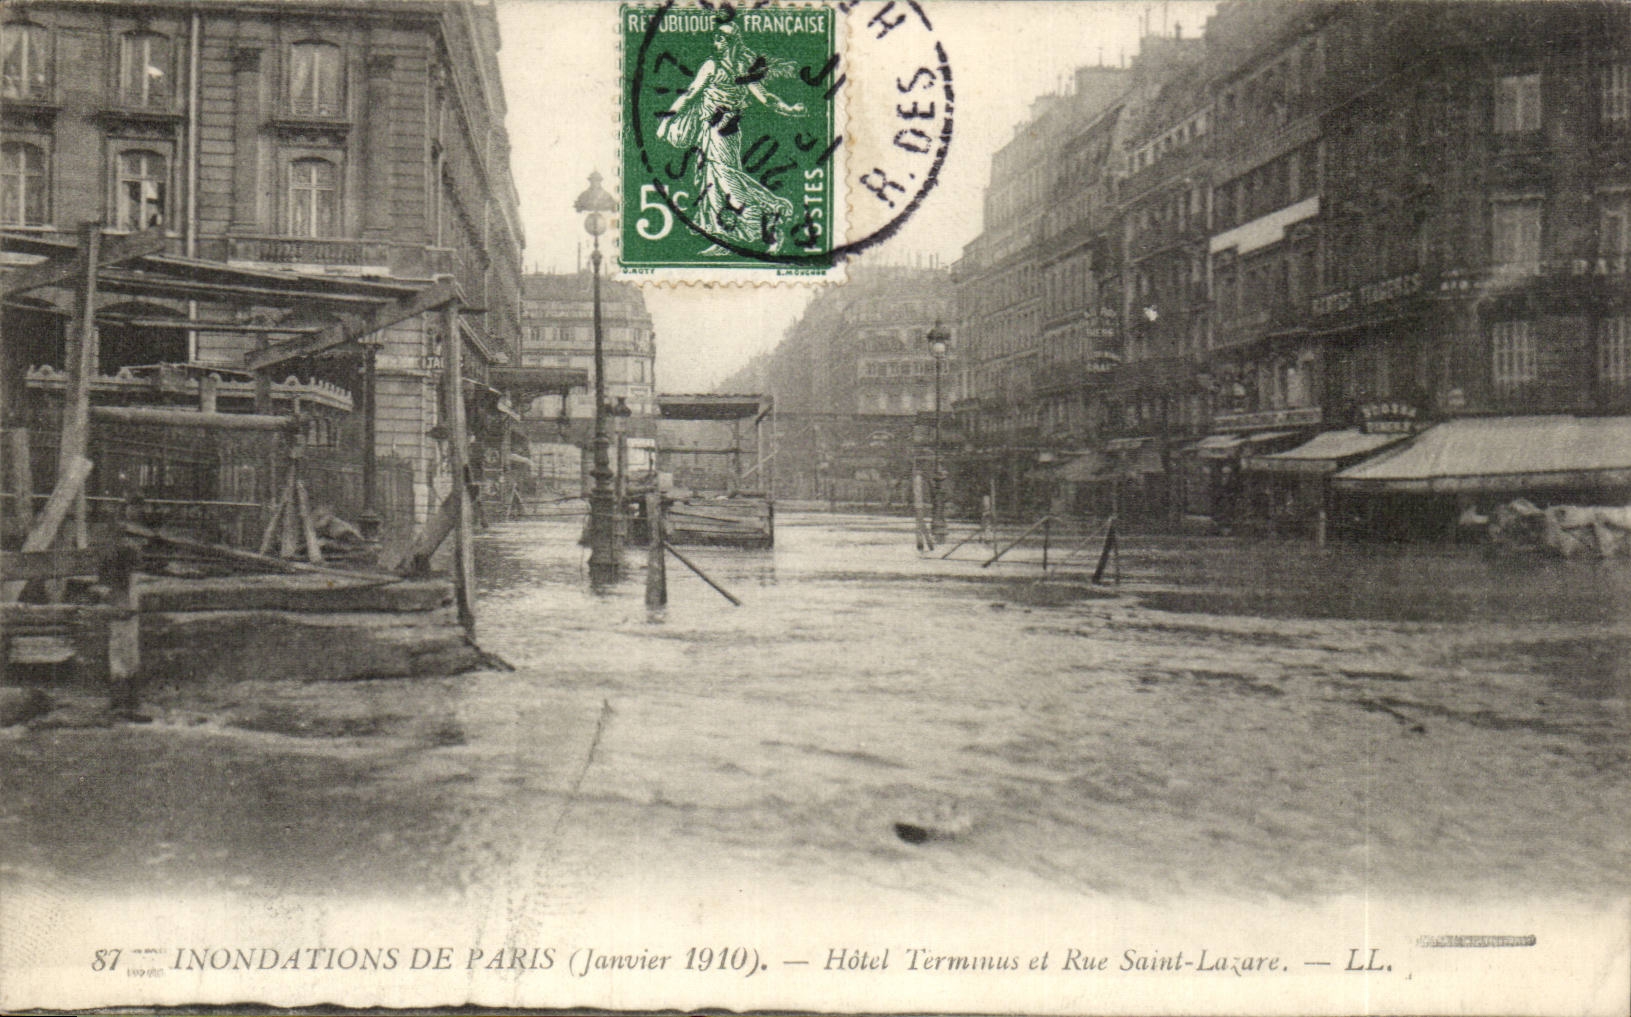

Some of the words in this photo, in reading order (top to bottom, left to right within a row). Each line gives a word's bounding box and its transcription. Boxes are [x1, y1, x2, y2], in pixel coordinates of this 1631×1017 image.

[627, 14, 717, 33] REUBLIQUE
[743, 15, 826, 35] FRANÇAISE
[893, 67, 938, 154] DES
